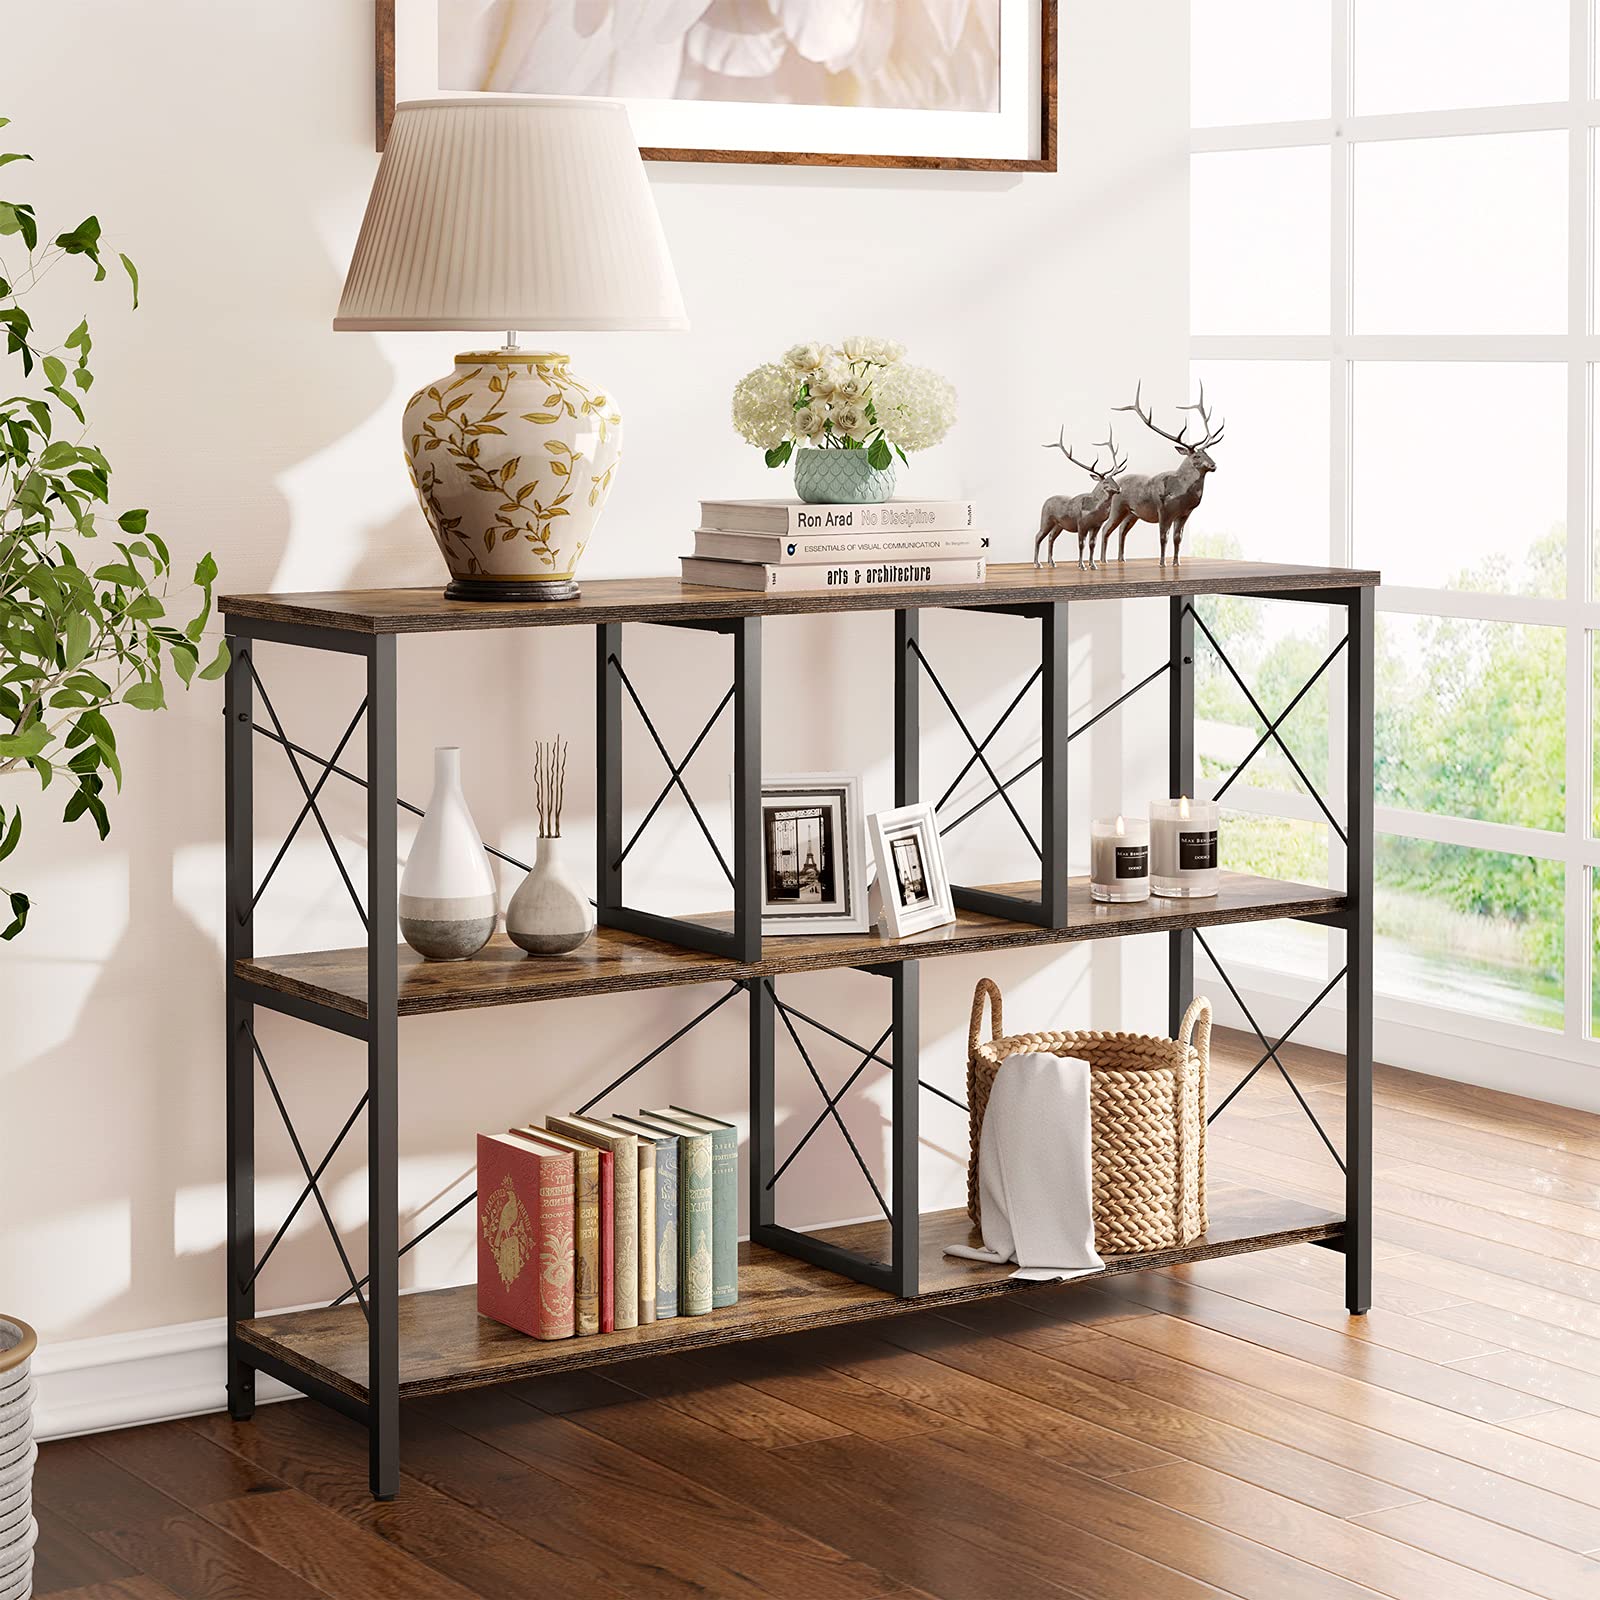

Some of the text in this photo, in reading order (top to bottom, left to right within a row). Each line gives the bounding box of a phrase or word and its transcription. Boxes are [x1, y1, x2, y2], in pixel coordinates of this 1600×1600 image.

[798, 508, 936, 528] Ron Arad No Discipline
[804, 544, 846, 553] ESSENTIALS
[858, 543, 882, 551] VISUAL
[883, 541, 941, 550] COMMUNICATION
[827, 564, 931, 585] arts & architecture
